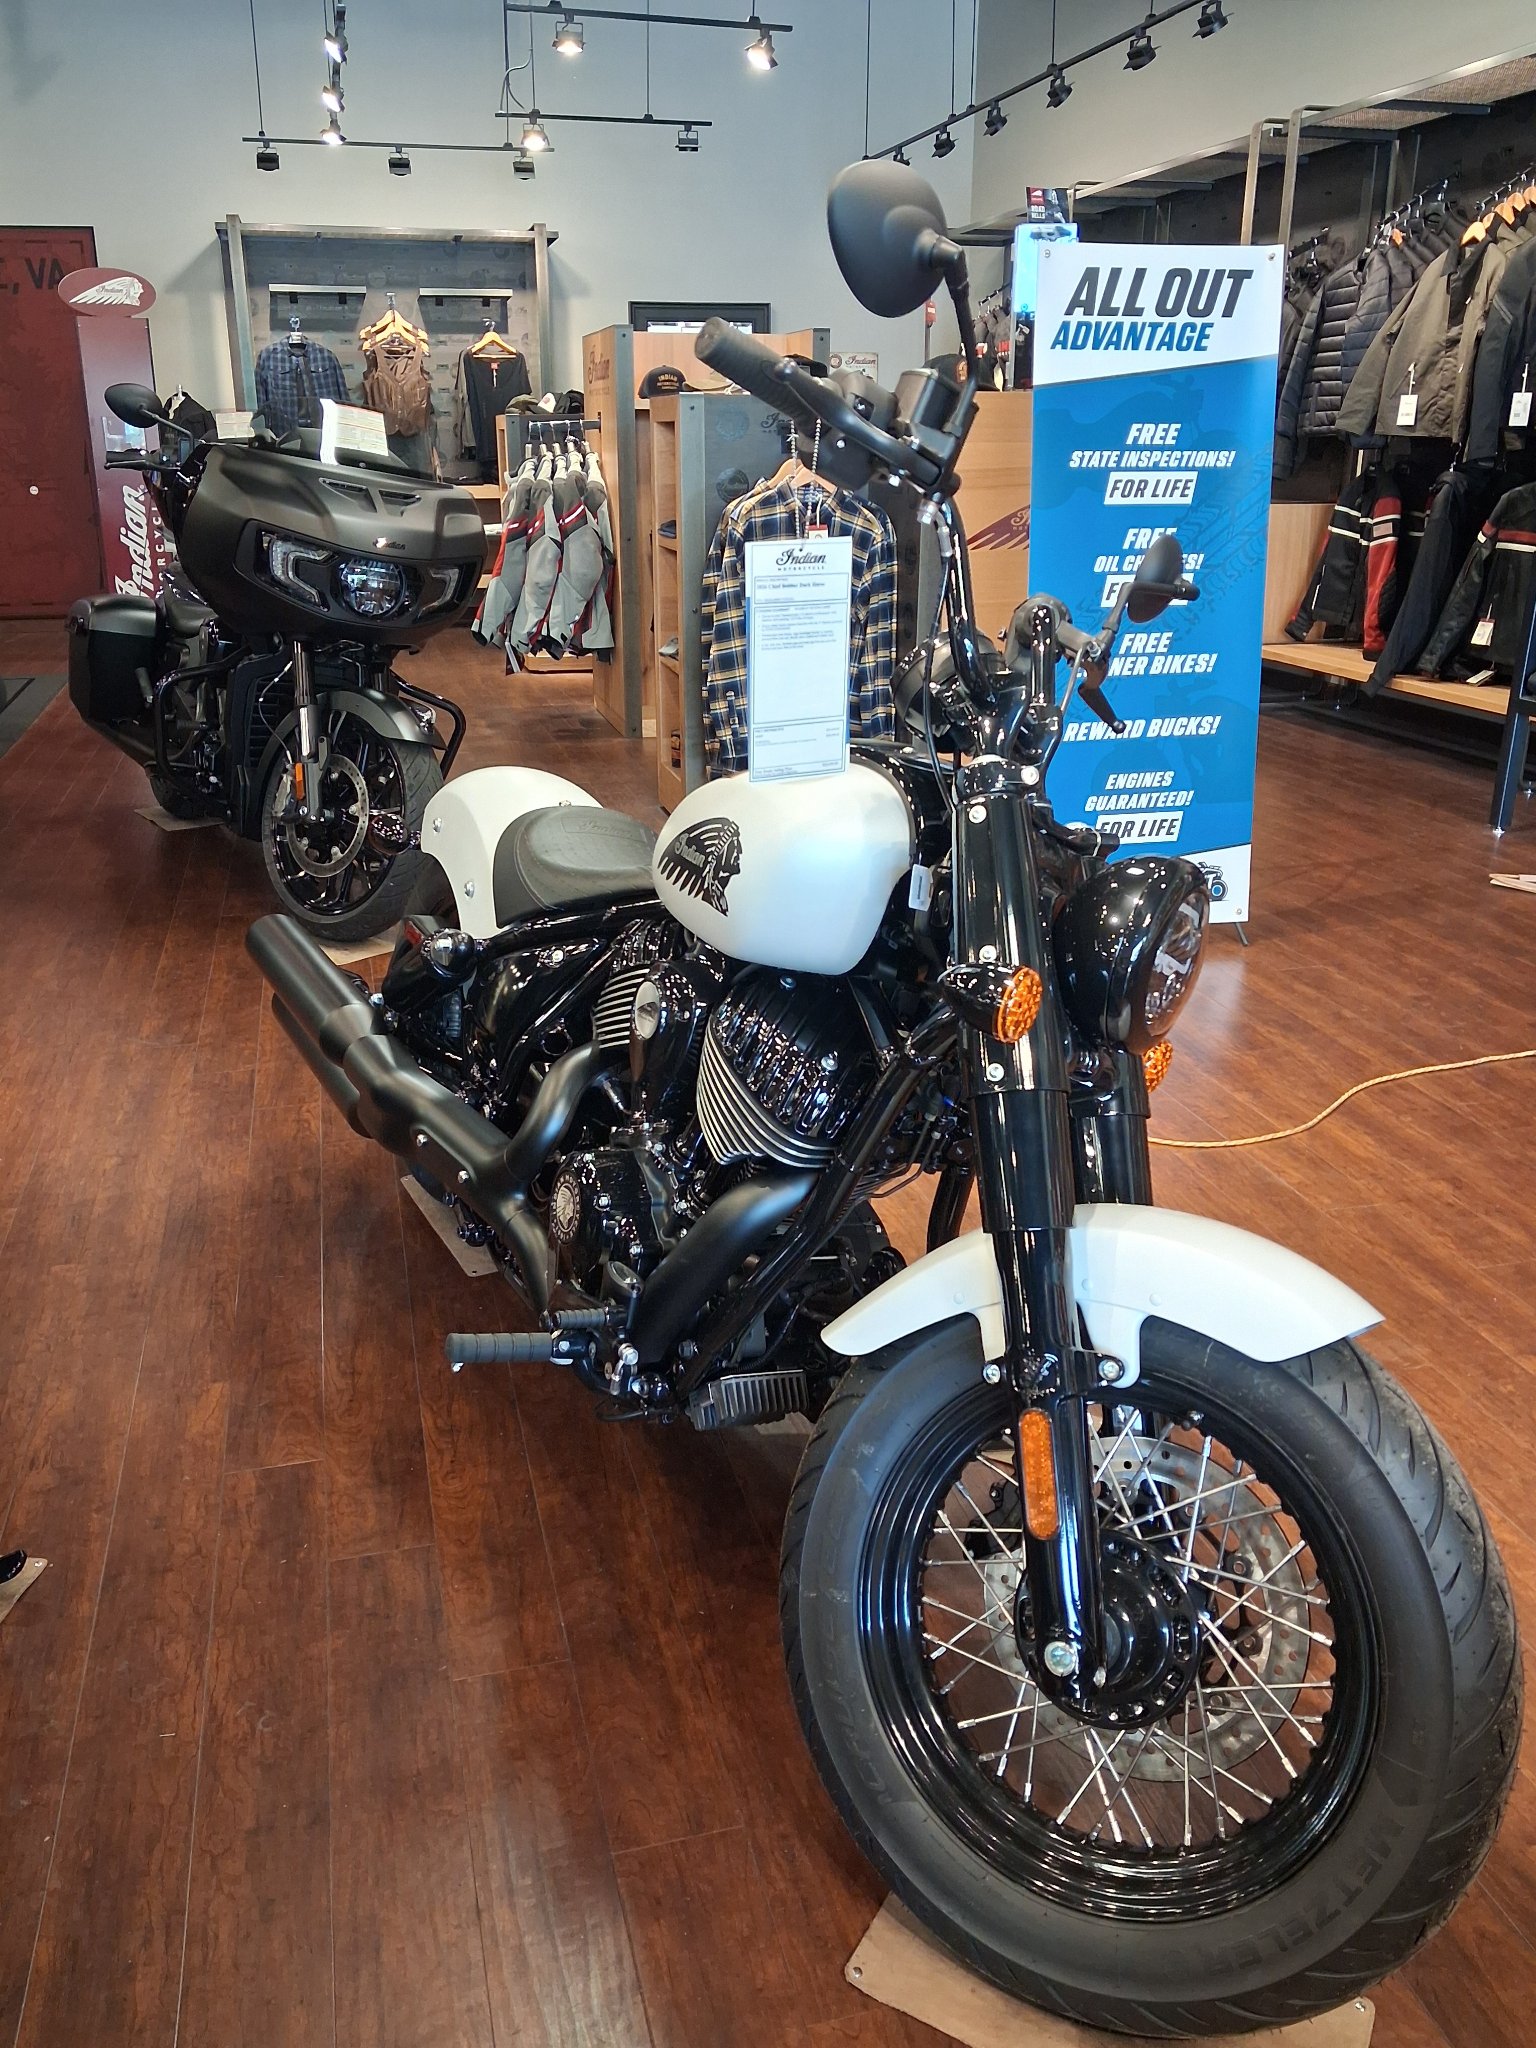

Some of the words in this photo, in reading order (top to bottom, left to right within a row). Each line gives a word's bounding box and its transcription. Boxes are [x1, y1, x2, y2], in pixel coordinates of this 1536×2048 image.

[1064, 266, 1148, 317] ALL
[1154, 267, 1254, 318] OUT
[1050, 320, 1214, 352] ADVANTAGE
[845, 355, 876, 365] Indian
[1125, 423, 1181, 445] FREE
[1069, 450, 1120, 468] STATE
[1120, 450, 1236, 468] INSPECTIONS!
[1109, 478, 1149, 498] FOR
[1150, 478, 1194, 498] LIFE
[776, 547, 826, 567] Indian
[1093, 555, 1120, 573] OIL
[1118, 631, 1173, 655] FREE
[1149, 652, 1218, 675] BIKES!
[1146, 715, 1221, 738] BUCKS!
[1105, 770, 1175, 790] ENGINES
[1084, 790, 1194, 812] GUARANTEED!
[1137, 817, 1180, 838] LIFE
[674, 832, 706, 868] Indian
